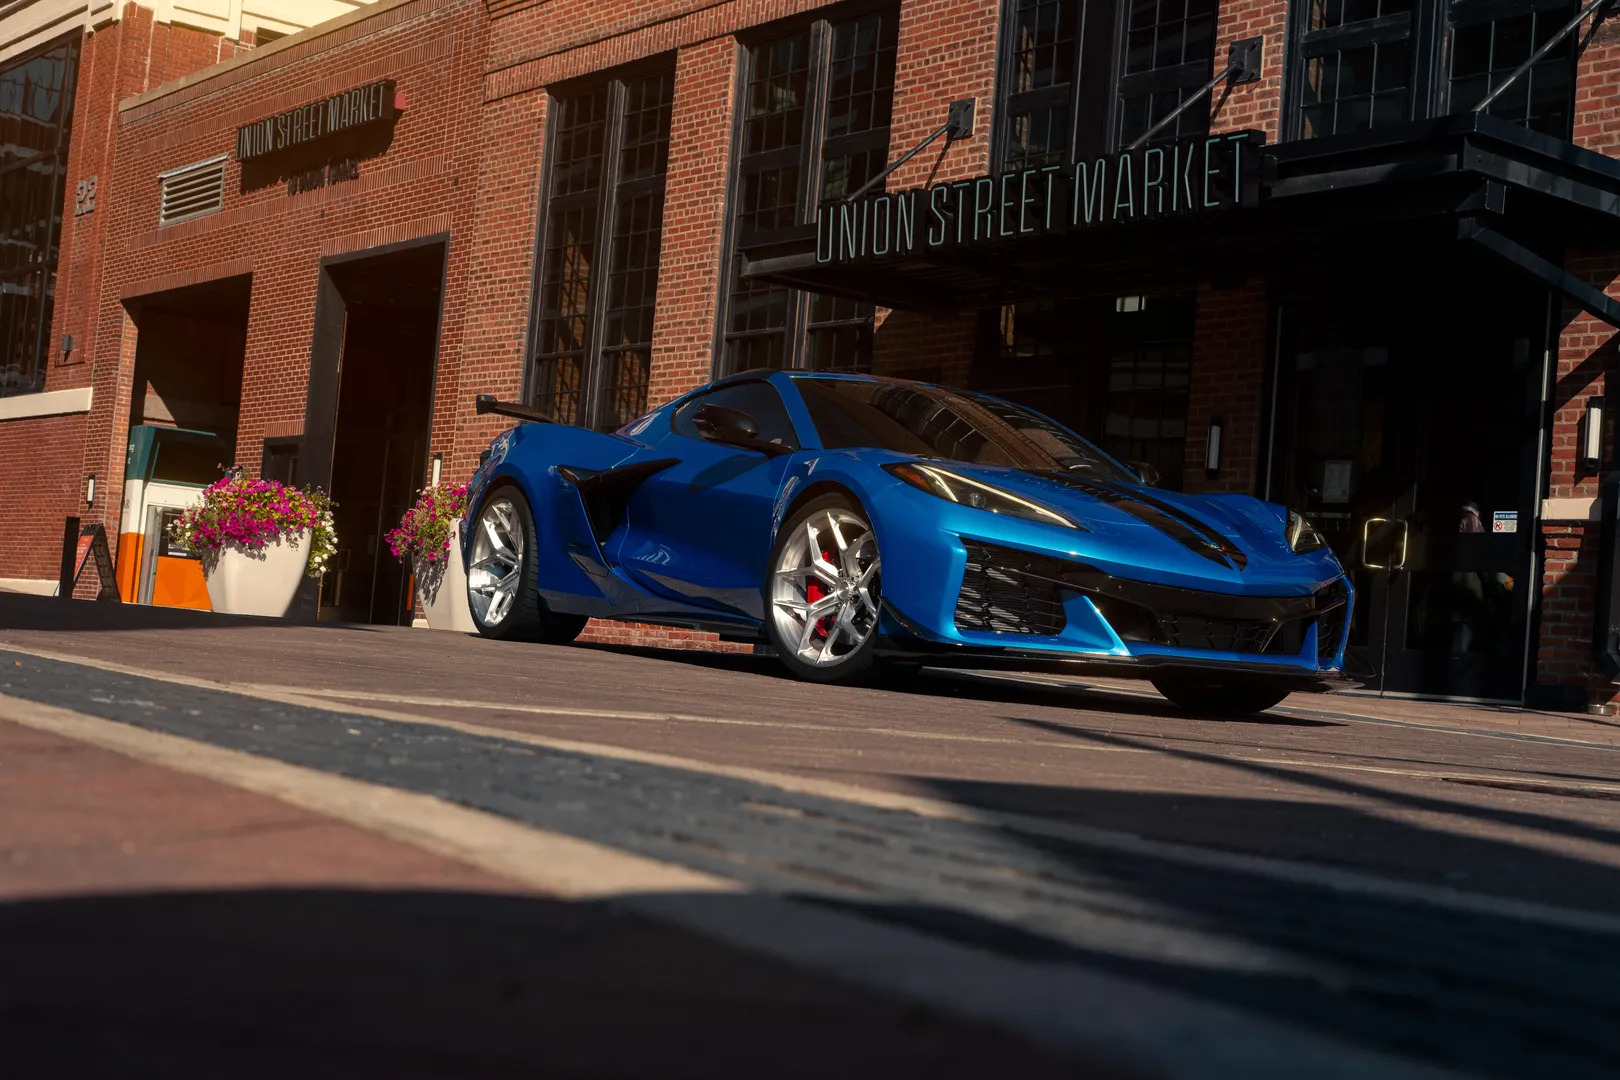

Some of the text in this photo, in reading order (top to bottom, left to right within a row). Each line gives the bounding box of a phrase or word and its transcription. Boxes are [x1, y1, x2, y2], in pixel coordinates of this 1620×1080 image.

[236, 81, 387, 161] UNION STREET MARKET
[75, 175, 98, 217] 22
[817, 134, 1249, 263] UNION STREET MARKET
